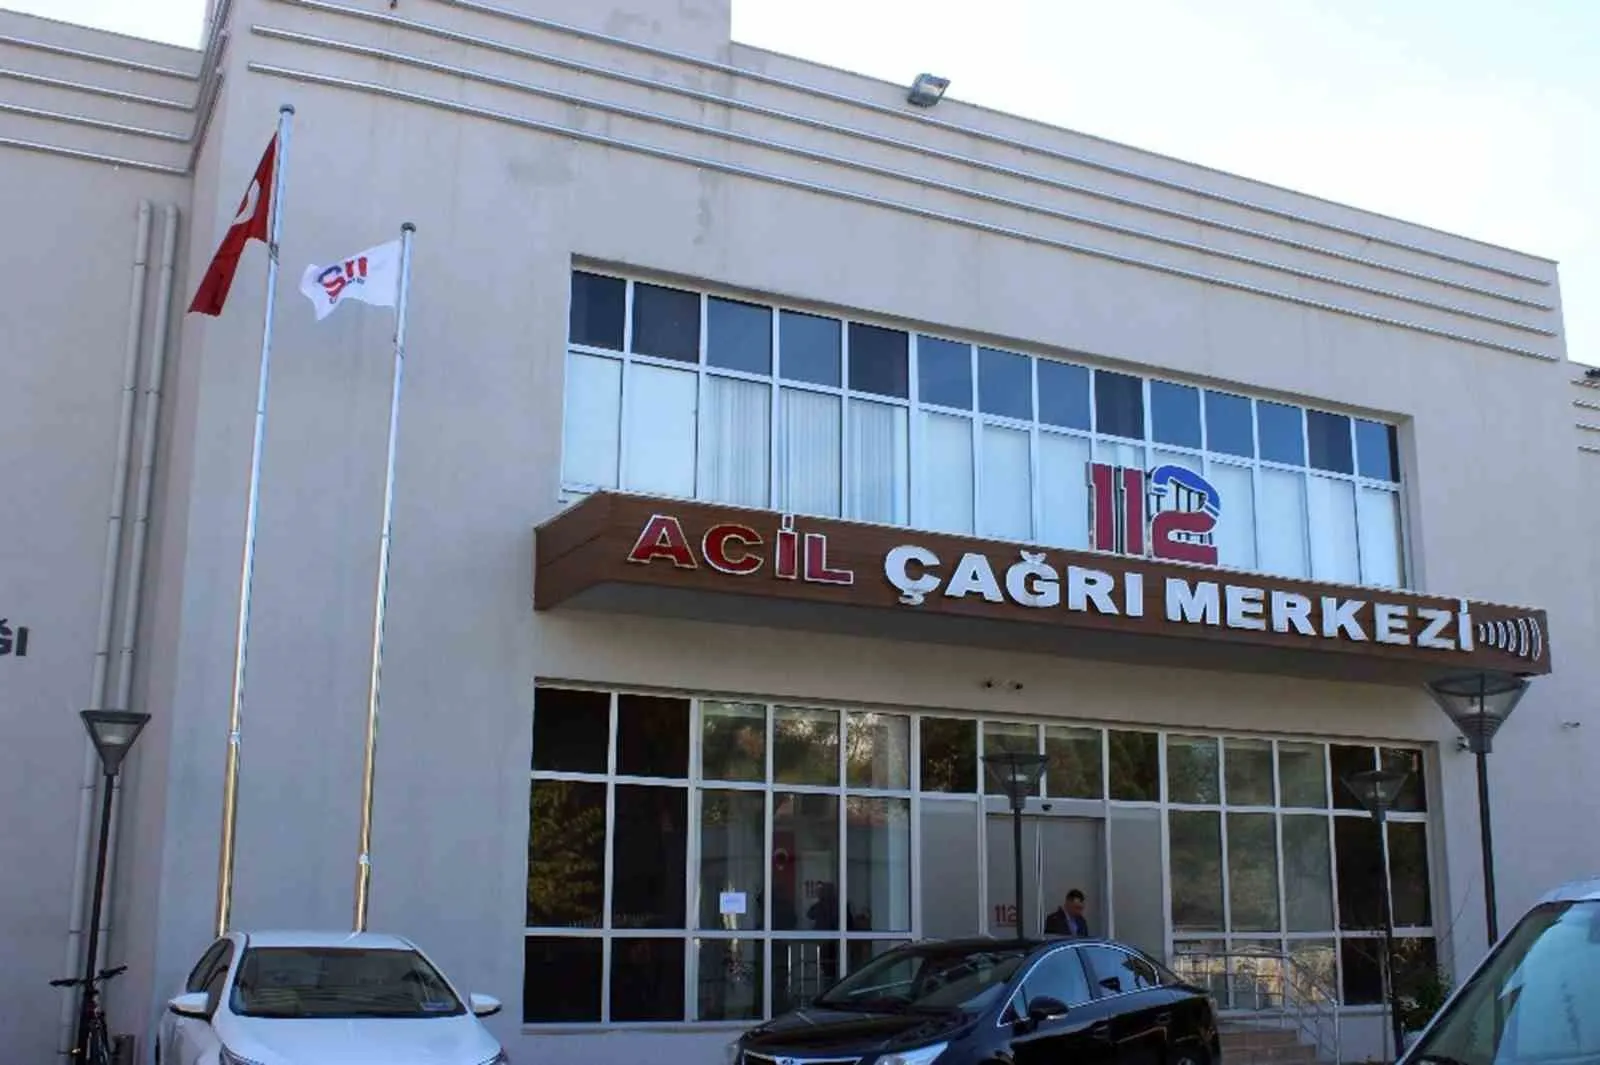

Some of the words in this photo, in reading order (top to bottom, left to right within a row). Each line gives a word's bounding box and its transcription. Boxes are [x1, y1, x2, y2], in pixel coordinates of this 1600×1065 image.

[1087, 462, 1220, 566] 112
[628, 514, 854, 584] ACİL
[885, 545, 1144, 617] ÇAĞRI
[1165, 577, 1475, 652] MERKEZİ
